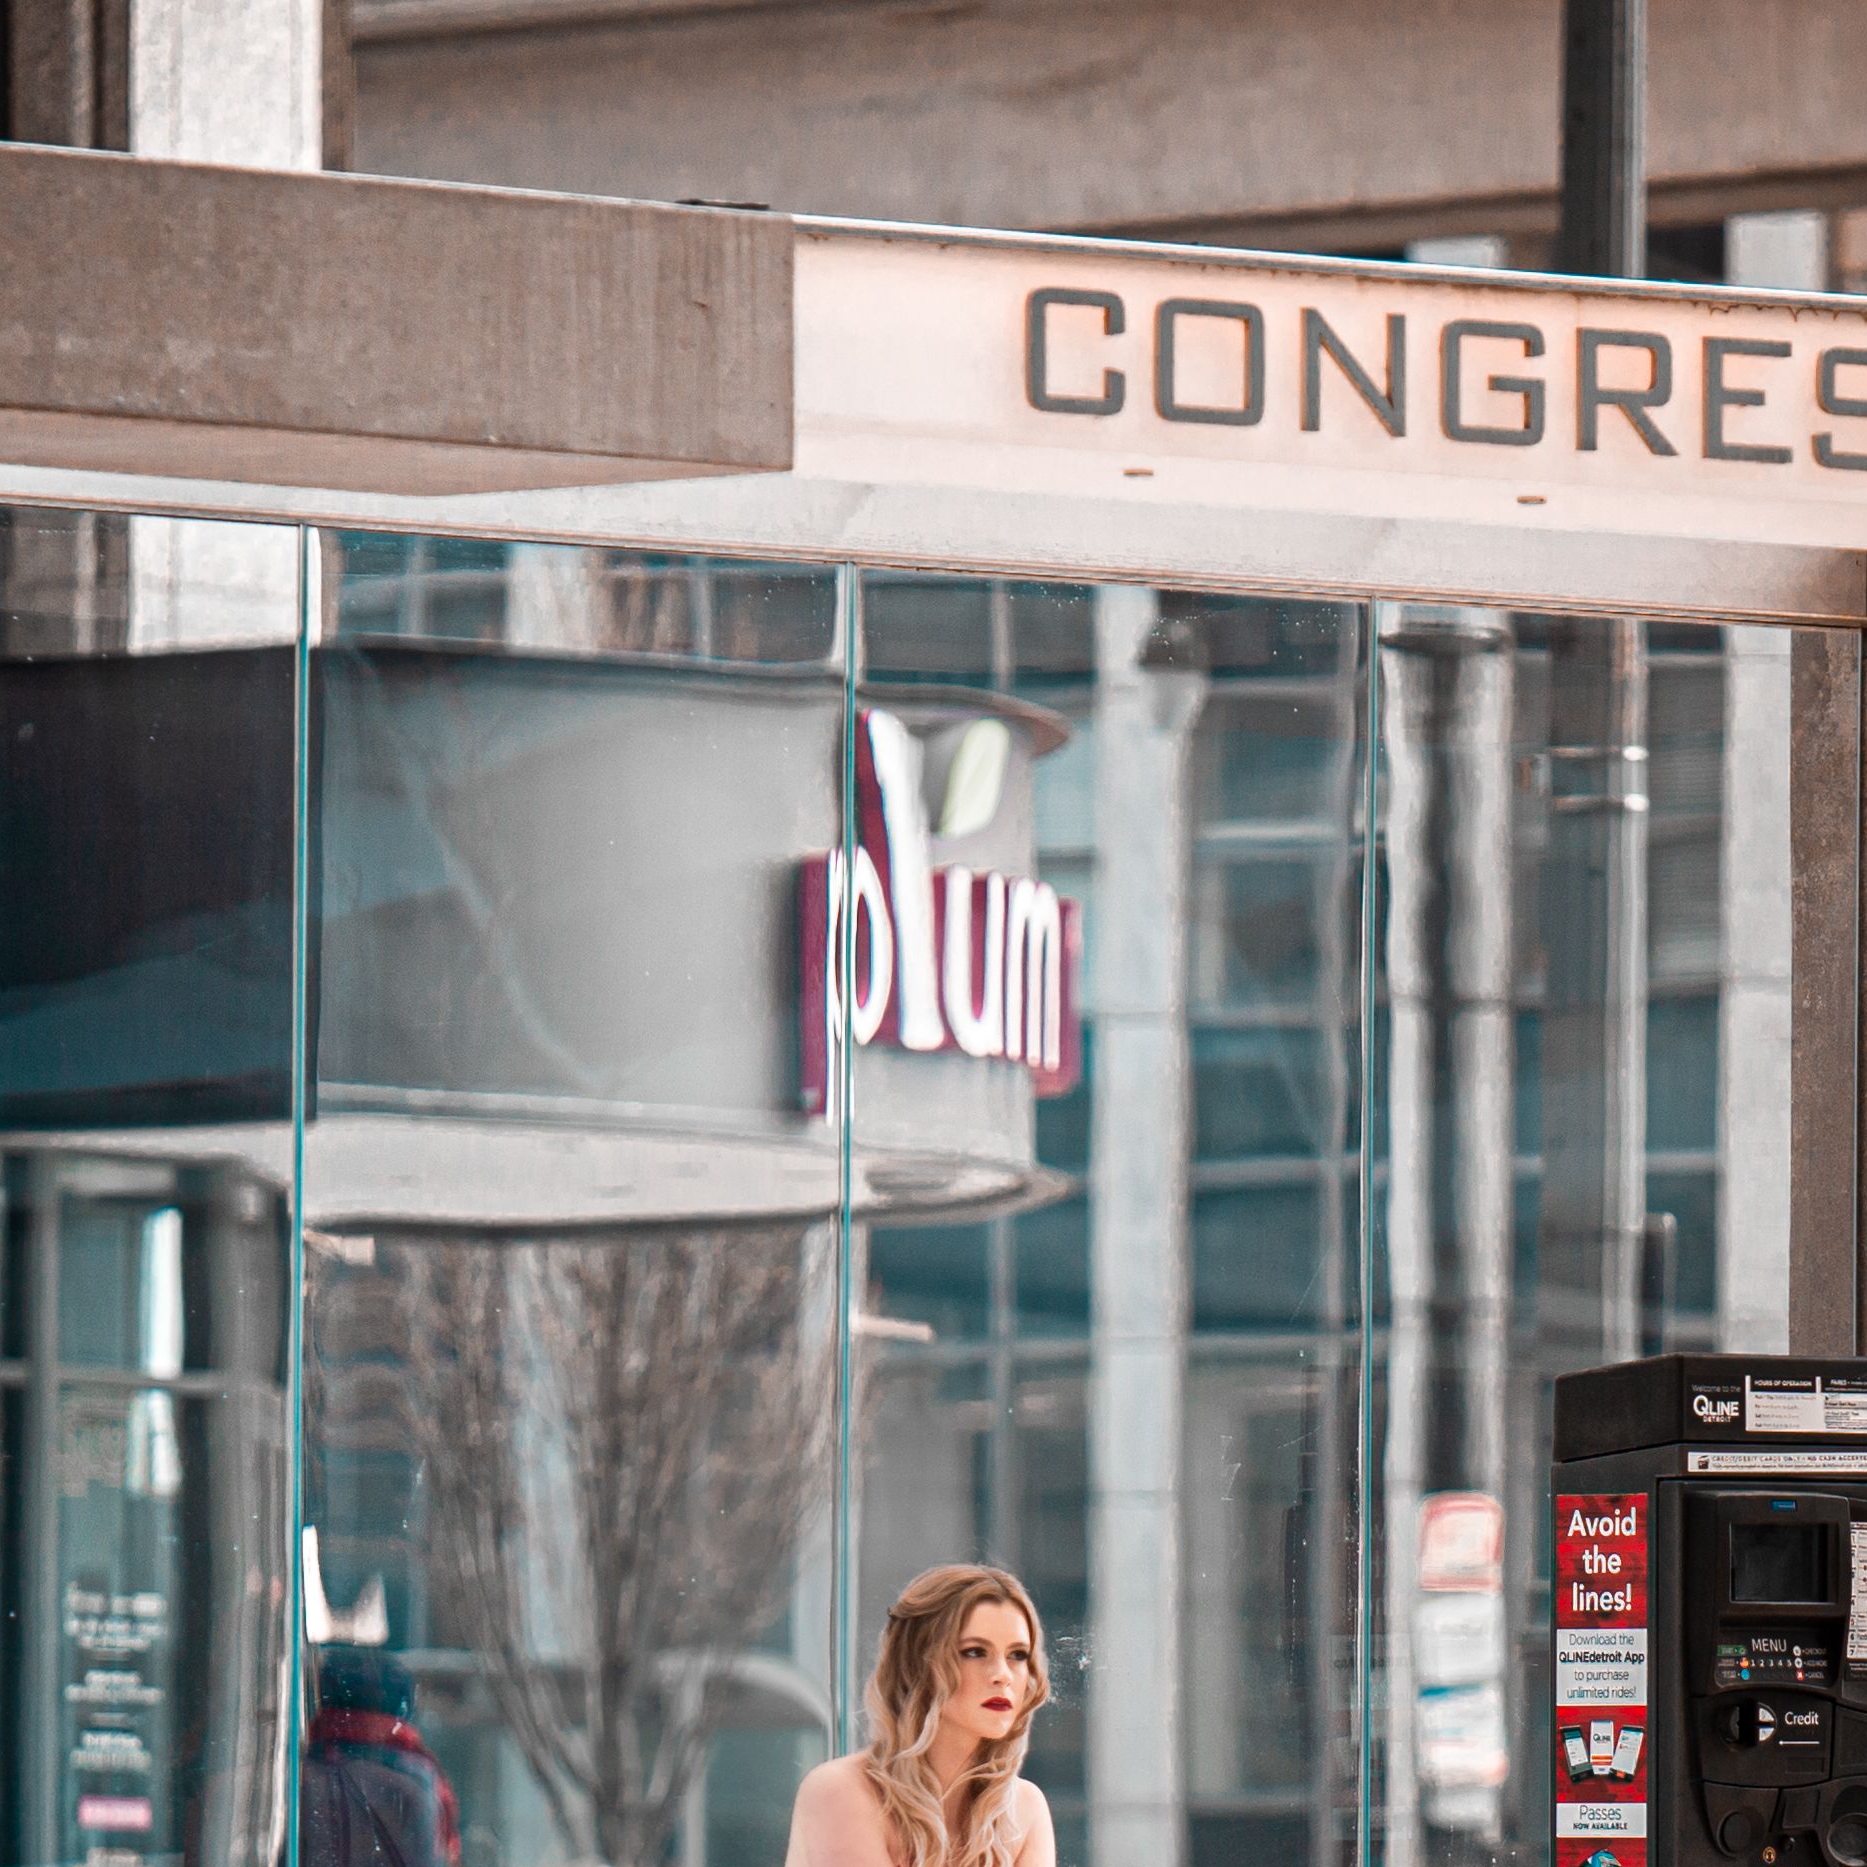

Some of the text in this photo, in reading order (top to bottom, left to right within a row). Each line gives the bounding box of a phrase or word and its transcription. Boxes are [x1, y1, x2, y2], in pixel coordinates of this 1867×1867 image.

[826, 708, 1061, 1127] plum
[1693, 1395, 1740, 1417] QLINE
[1568, 1507, 1637, 1537] Avoid
[1583, 1544, 1622, 1575] the
[1572, 1582, 1633, 1612] lines!
[1569, 1633, 1634, 1646] Download the
[1751, 1639, 1787, 1652] MENU
[1559, 1651, 1645, 1665] QLINEdetroit App
[1759, 1659, 1765, 1667] 2
[1769, 1659, 1774, 1667] 3
[1777, 1659, 1783, 1667] 4
[1787, 1659, 1792, 1667] 5
[1574, 1669, 1629, 1683] to purchase
[1567, 1686, 1637, 1699] unlimited rides!
[1784, 1711, 1820, 1725] Credit
[1579, 1805, 1622, 1820] Passes
